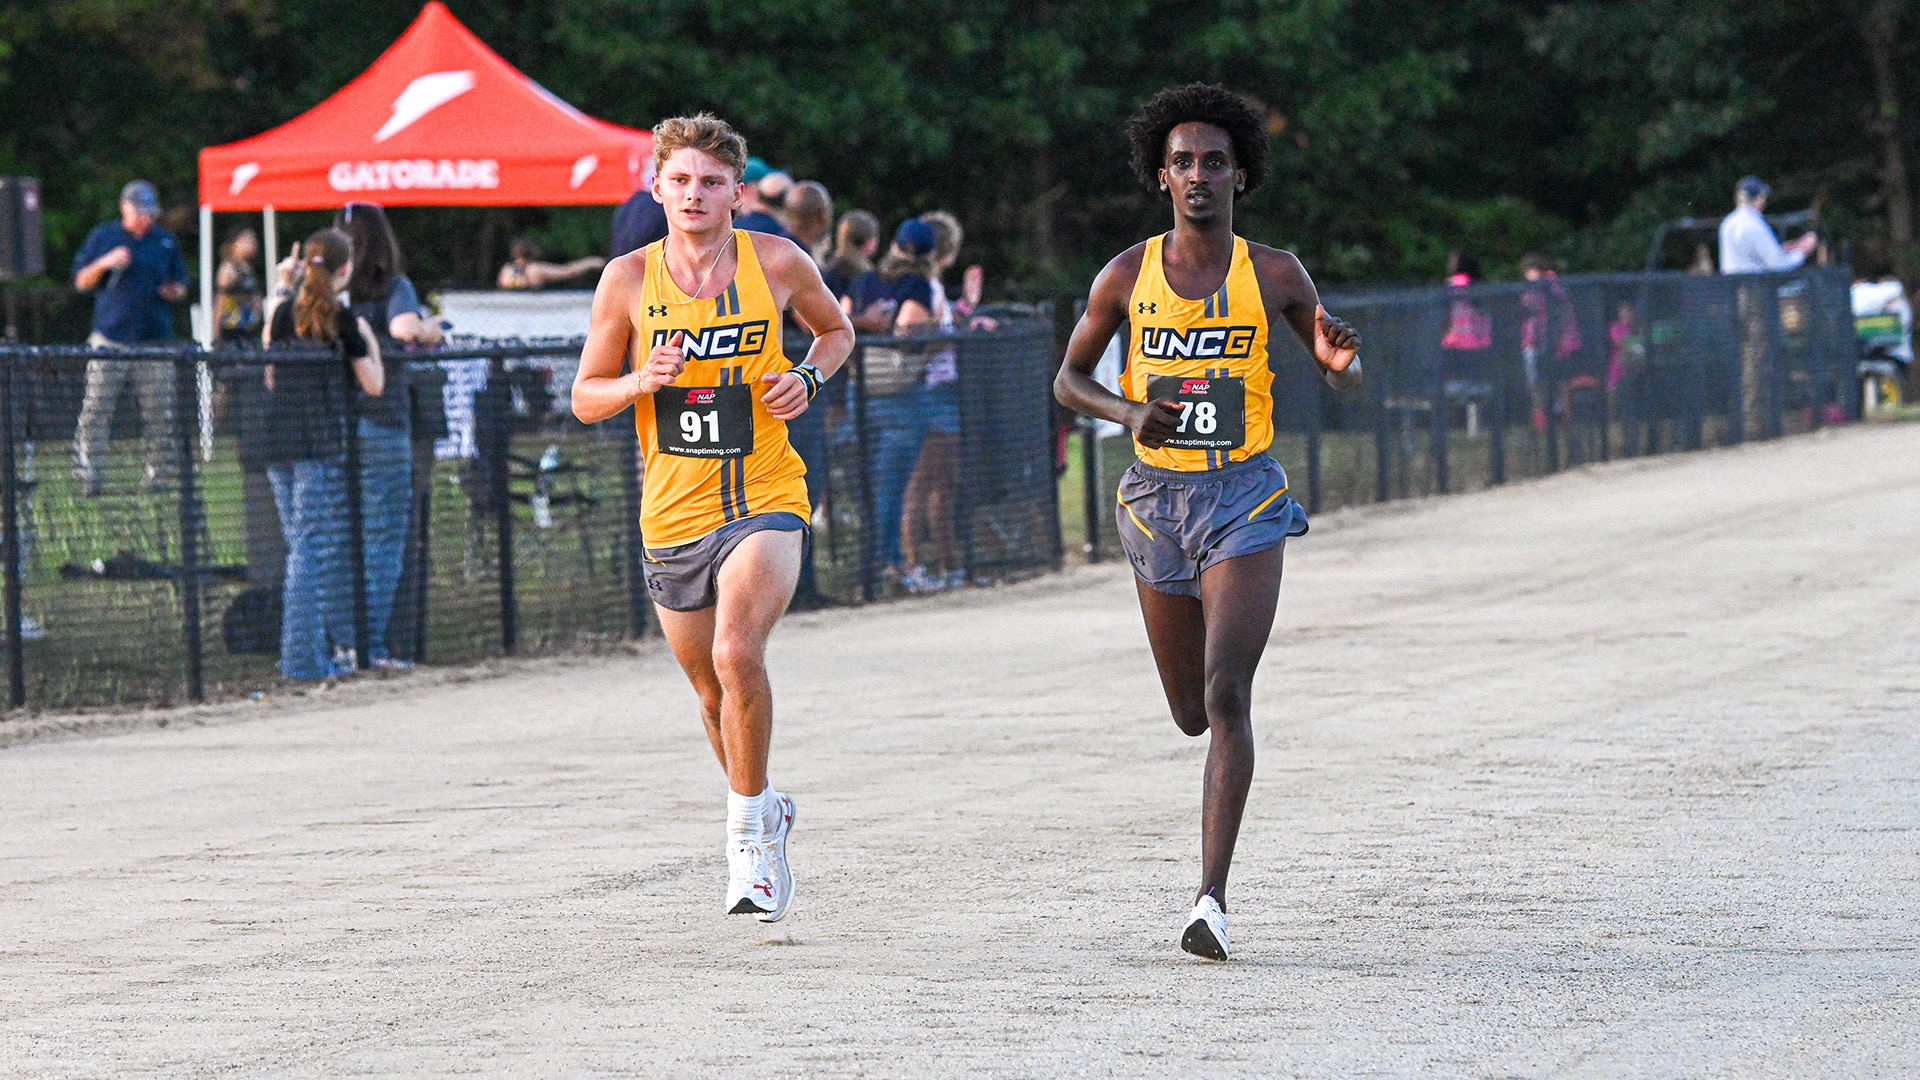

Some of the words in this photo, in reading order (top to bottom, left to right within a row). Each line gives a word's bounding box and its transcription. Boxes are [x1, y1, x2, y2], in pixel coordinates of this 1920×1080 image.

[327, 159, 500, 192] GATORADE
[1142, 326, 1257, 360] UNCG
[685, 389, 716, 404] SNAP
[1179, 379, 1211, 394] SNAP
[679, 410, 720, 443] 91
[1176, 401, 1217, 434] 78
[668, 445, 741, 456] www.snaptiming.com
